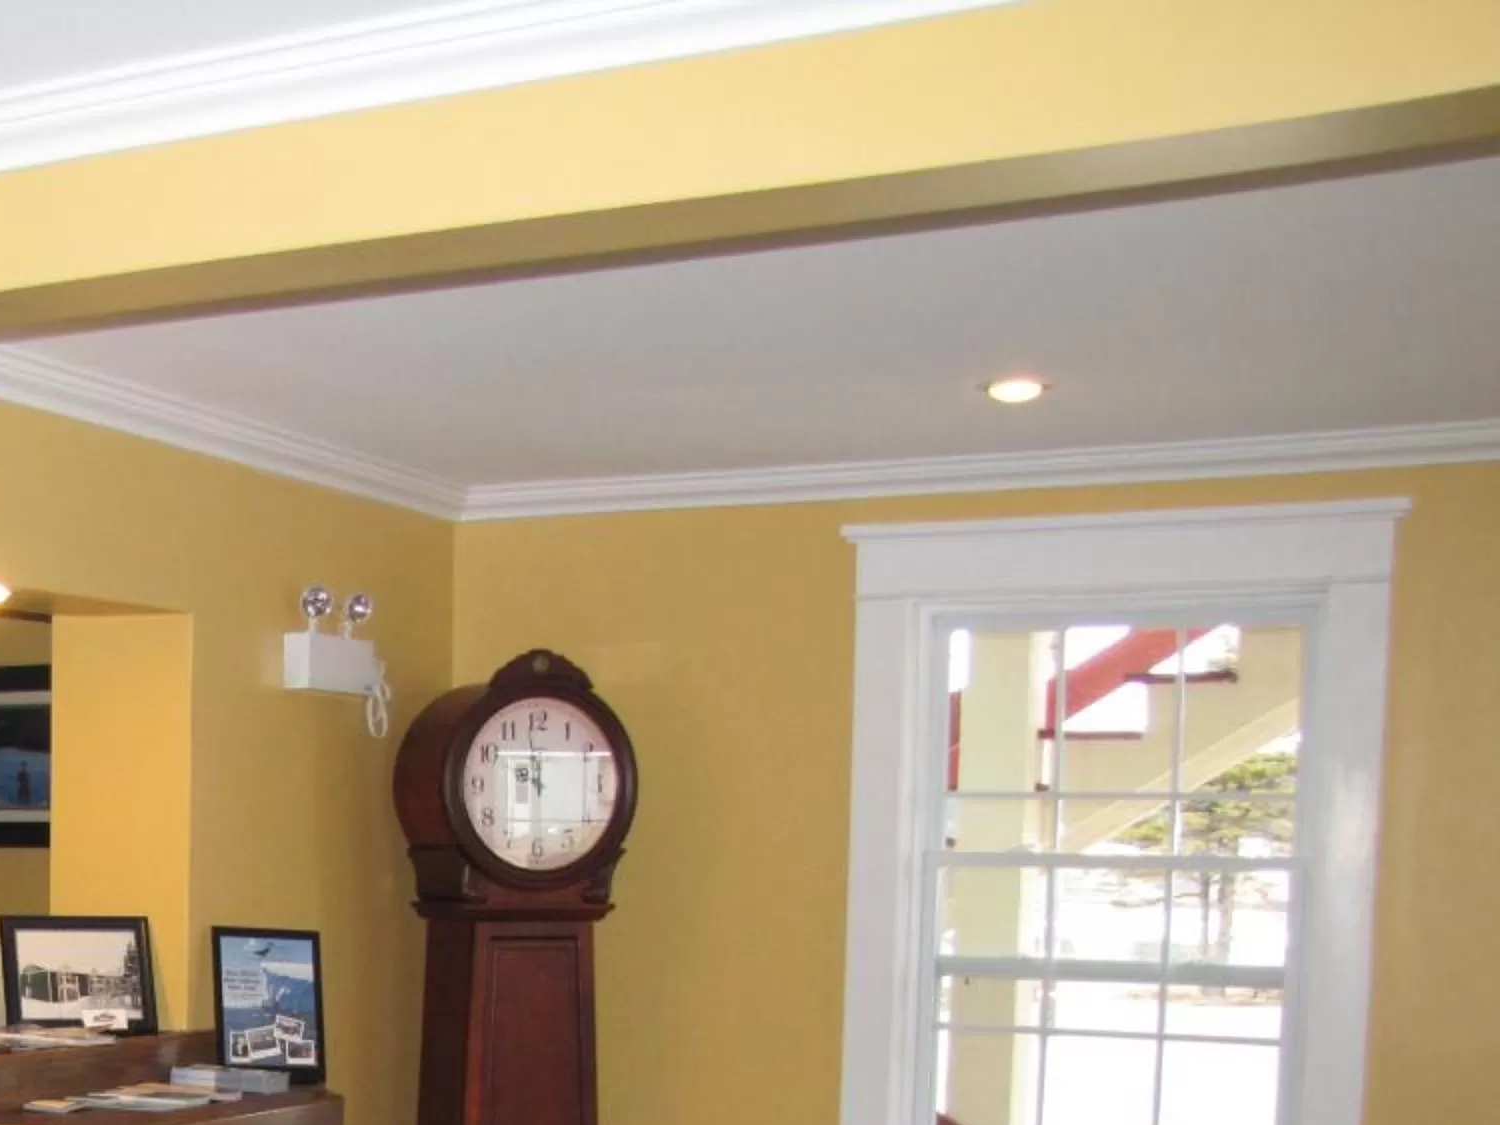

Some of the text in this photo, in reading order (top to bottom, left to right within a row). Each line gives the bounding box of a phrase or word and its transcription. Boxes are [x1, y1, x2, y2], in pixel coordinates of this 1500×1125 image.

[501, 720, 516, 741] 11
[529, 710, 548, 732] 12
[564, 720, 572, 741] 1
[480, 743, 498, 768] 10
[471, 775, 485, 796] 9
[480, 806, 495, 828] 8
[531, 838, 544, 859] 6
